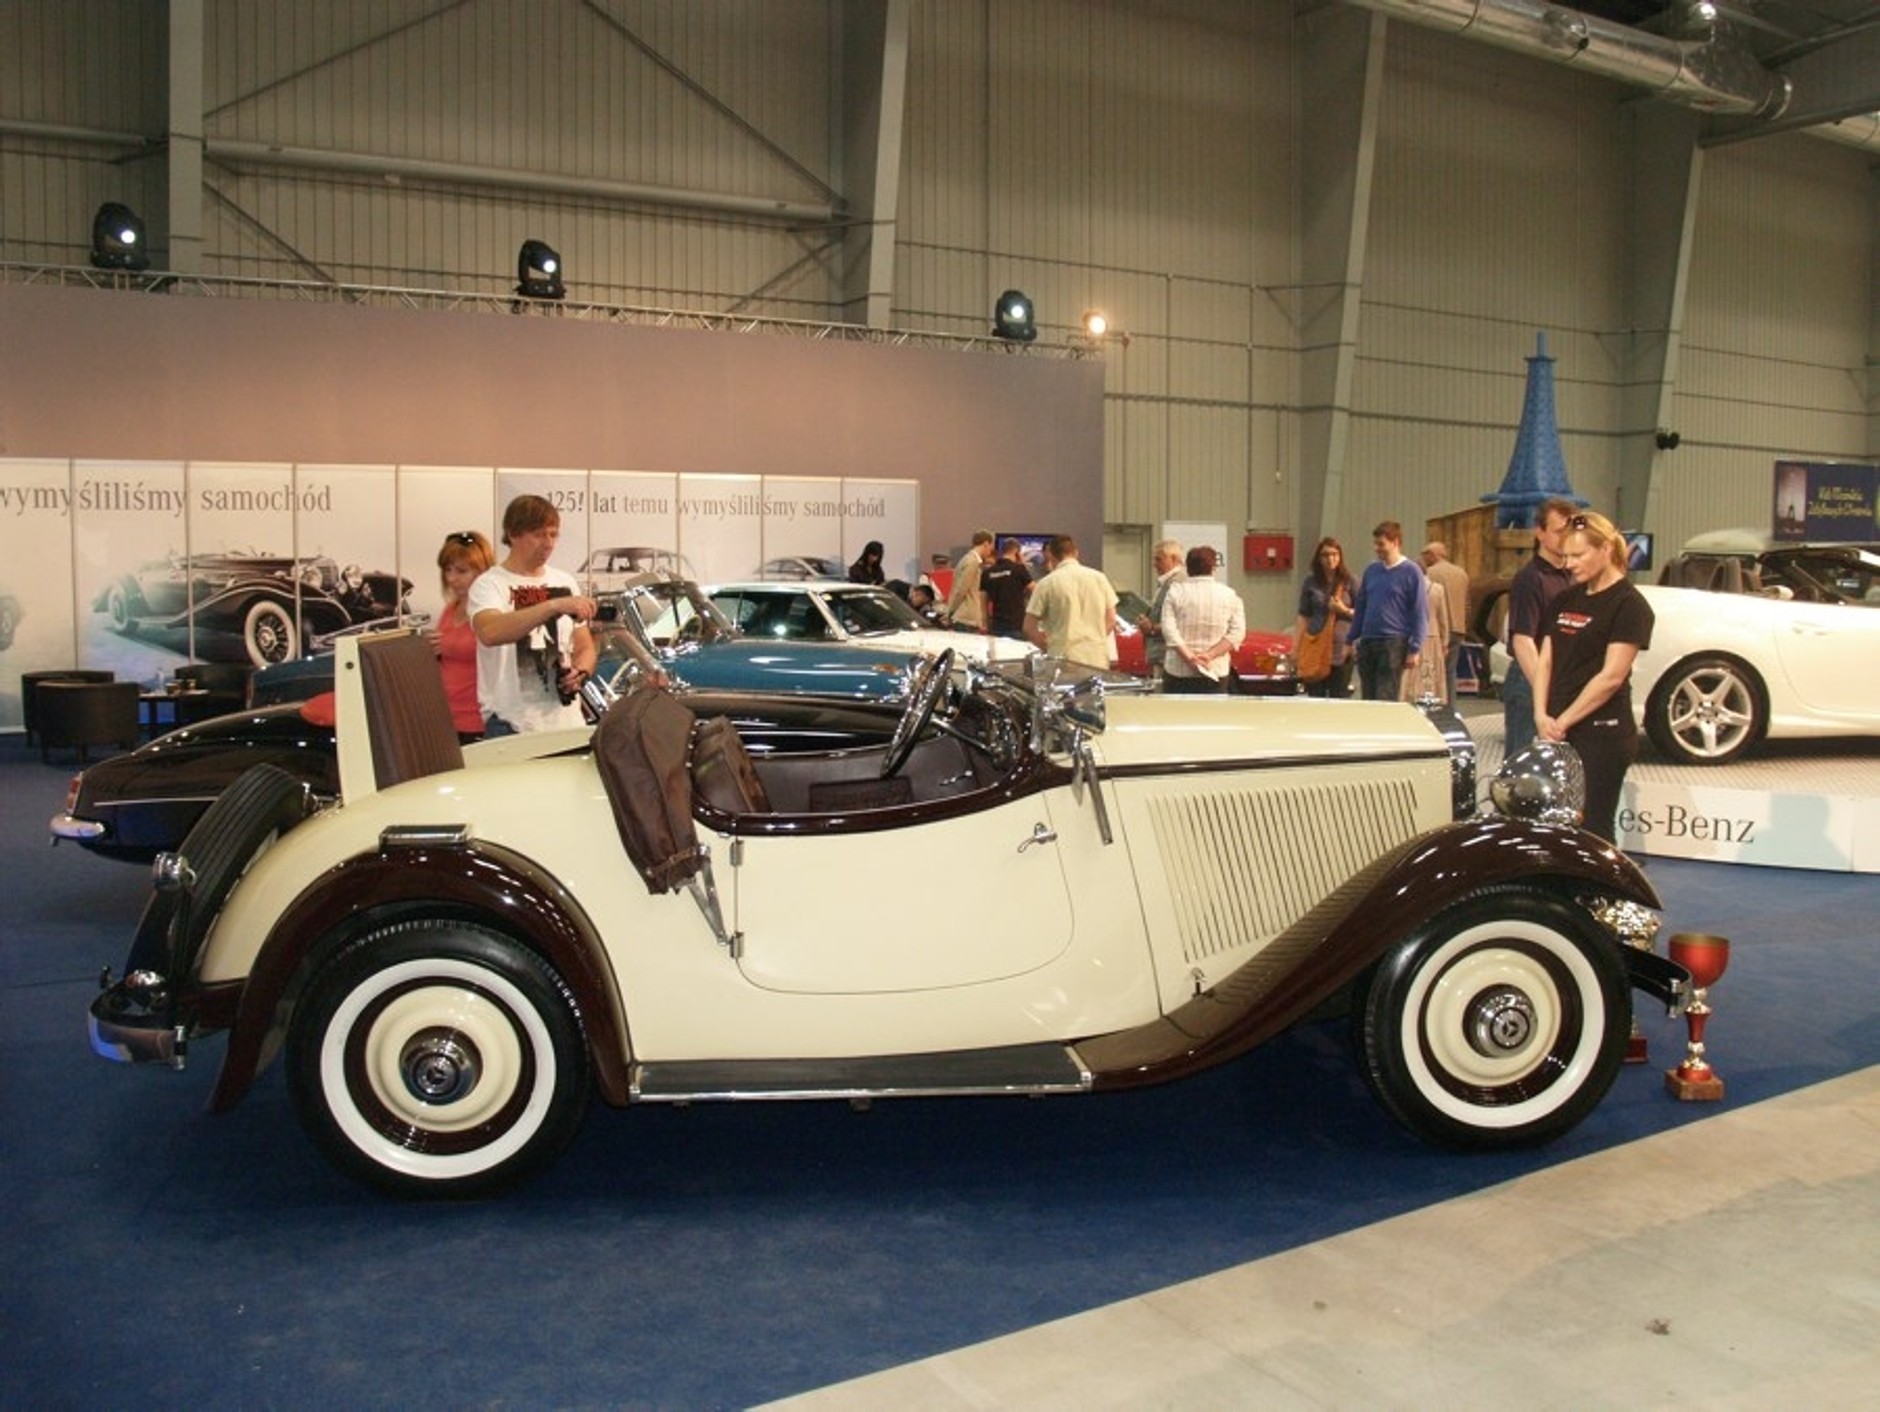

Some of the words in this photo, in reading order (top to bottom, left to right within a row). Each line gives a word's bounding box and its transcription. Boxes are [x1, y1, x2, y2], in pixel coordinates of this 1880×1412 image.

[201, 484, 332, 512] samochód
[593, 491, 616, 513] lat
[624, 496, 668, 514] temu
[803, 497, 886, 518] samochód
